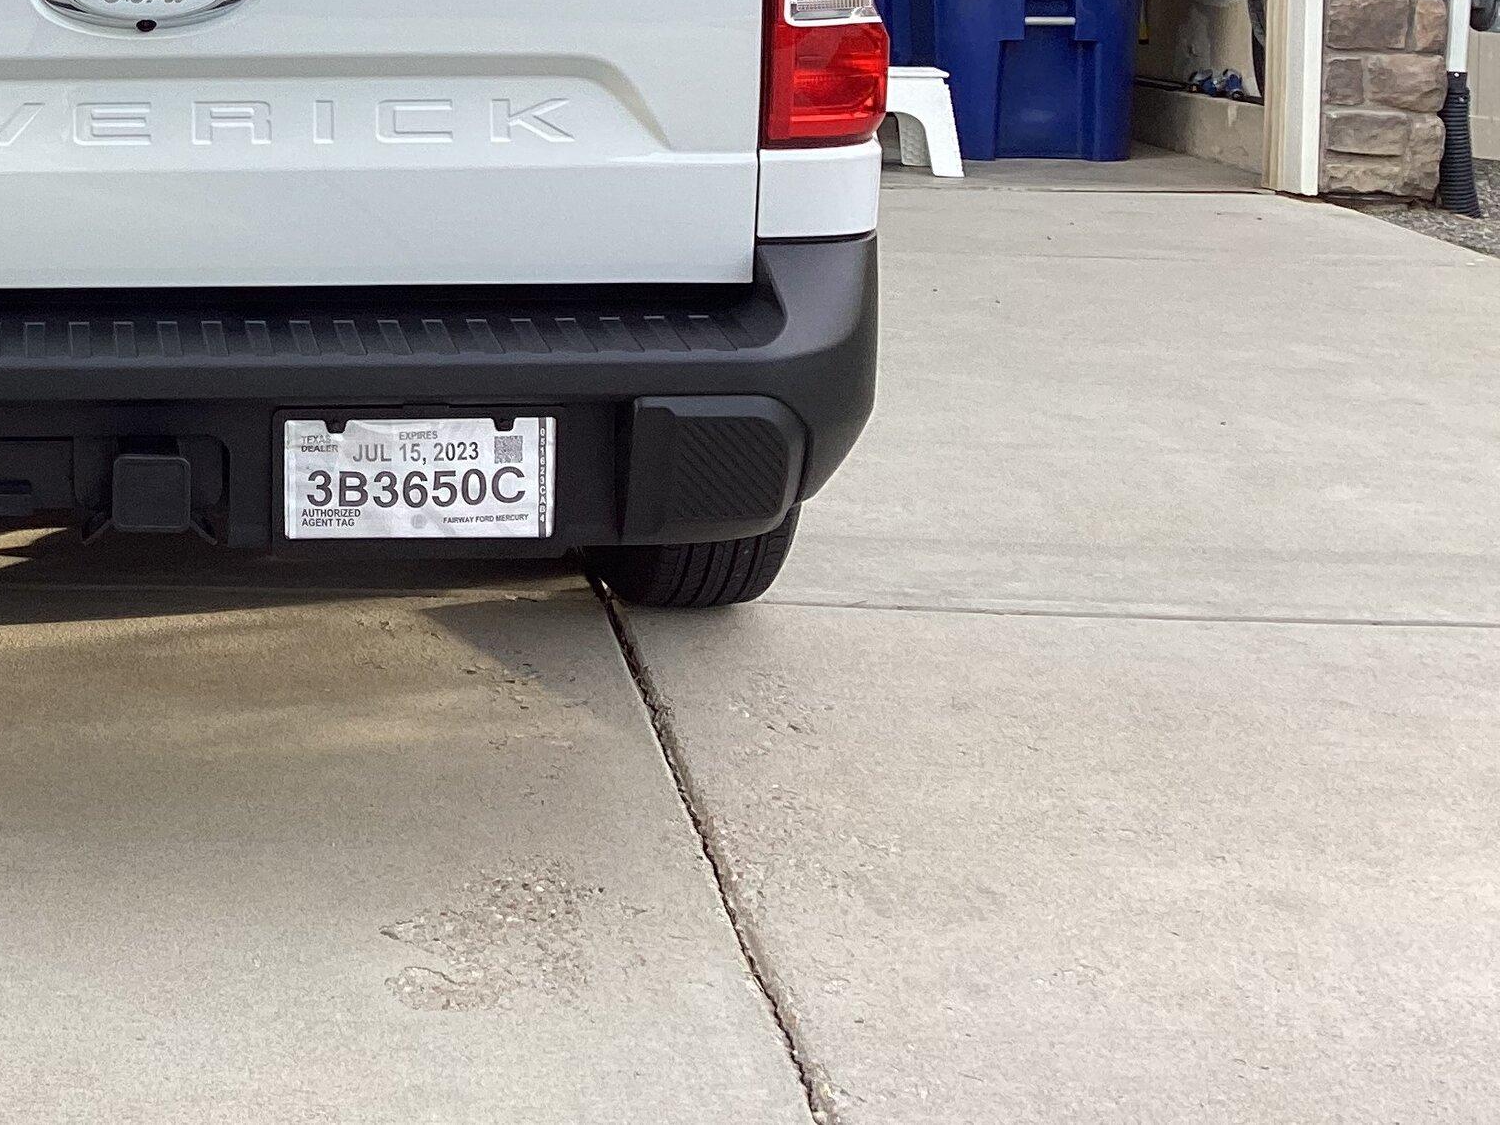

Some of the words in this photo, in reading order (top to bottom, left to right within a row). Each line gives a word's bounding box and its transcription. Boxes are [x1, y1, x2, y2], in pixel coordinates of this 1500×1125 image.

[301, 435, 331, 444] TEXAS
[399, 430, 438, 440] EXPIRES
[301, 444, 339, 453] DEALER
[352, 443, 392, 462] JUL
[399, 443, 427, 465] 15,
[433, 441, 479, 462] 2023
[306, 466, 526, 509] 3B3650C
[301, 508, 361, 518] AUTHORIZED
[301, 518, 334, 527] AGENT
[335, 518, 355, 527] TAG
[443, 516, 474, 524] FAIRWAY
[475, 515, 495, 523] FORD
[496, 513, 529, 522] MERCURY
